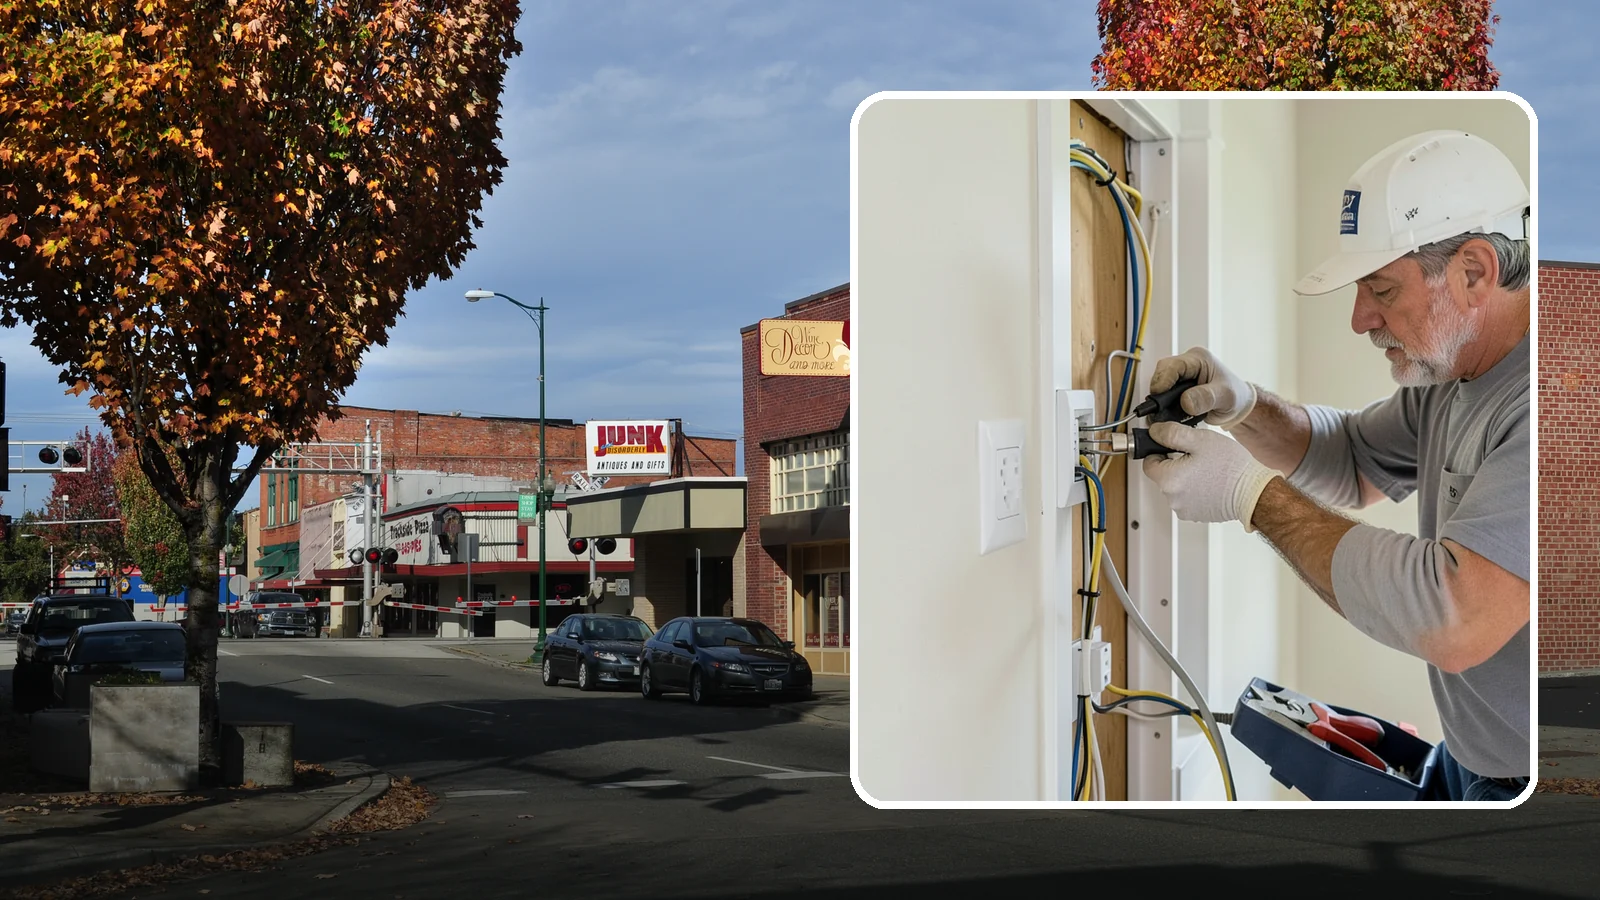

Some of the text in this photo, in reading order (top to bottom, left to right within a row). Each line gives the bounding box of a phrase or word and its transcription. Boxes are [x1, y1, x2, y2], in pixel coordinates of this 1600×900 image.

[595, 425, 664, 457] JUNK
[607, 446, 646, 454] DISORDERLY
[597, 460, 665, 470] ANTIQUES AND GIFTS
[390, 519, 429, 540] Trackside Pizza
